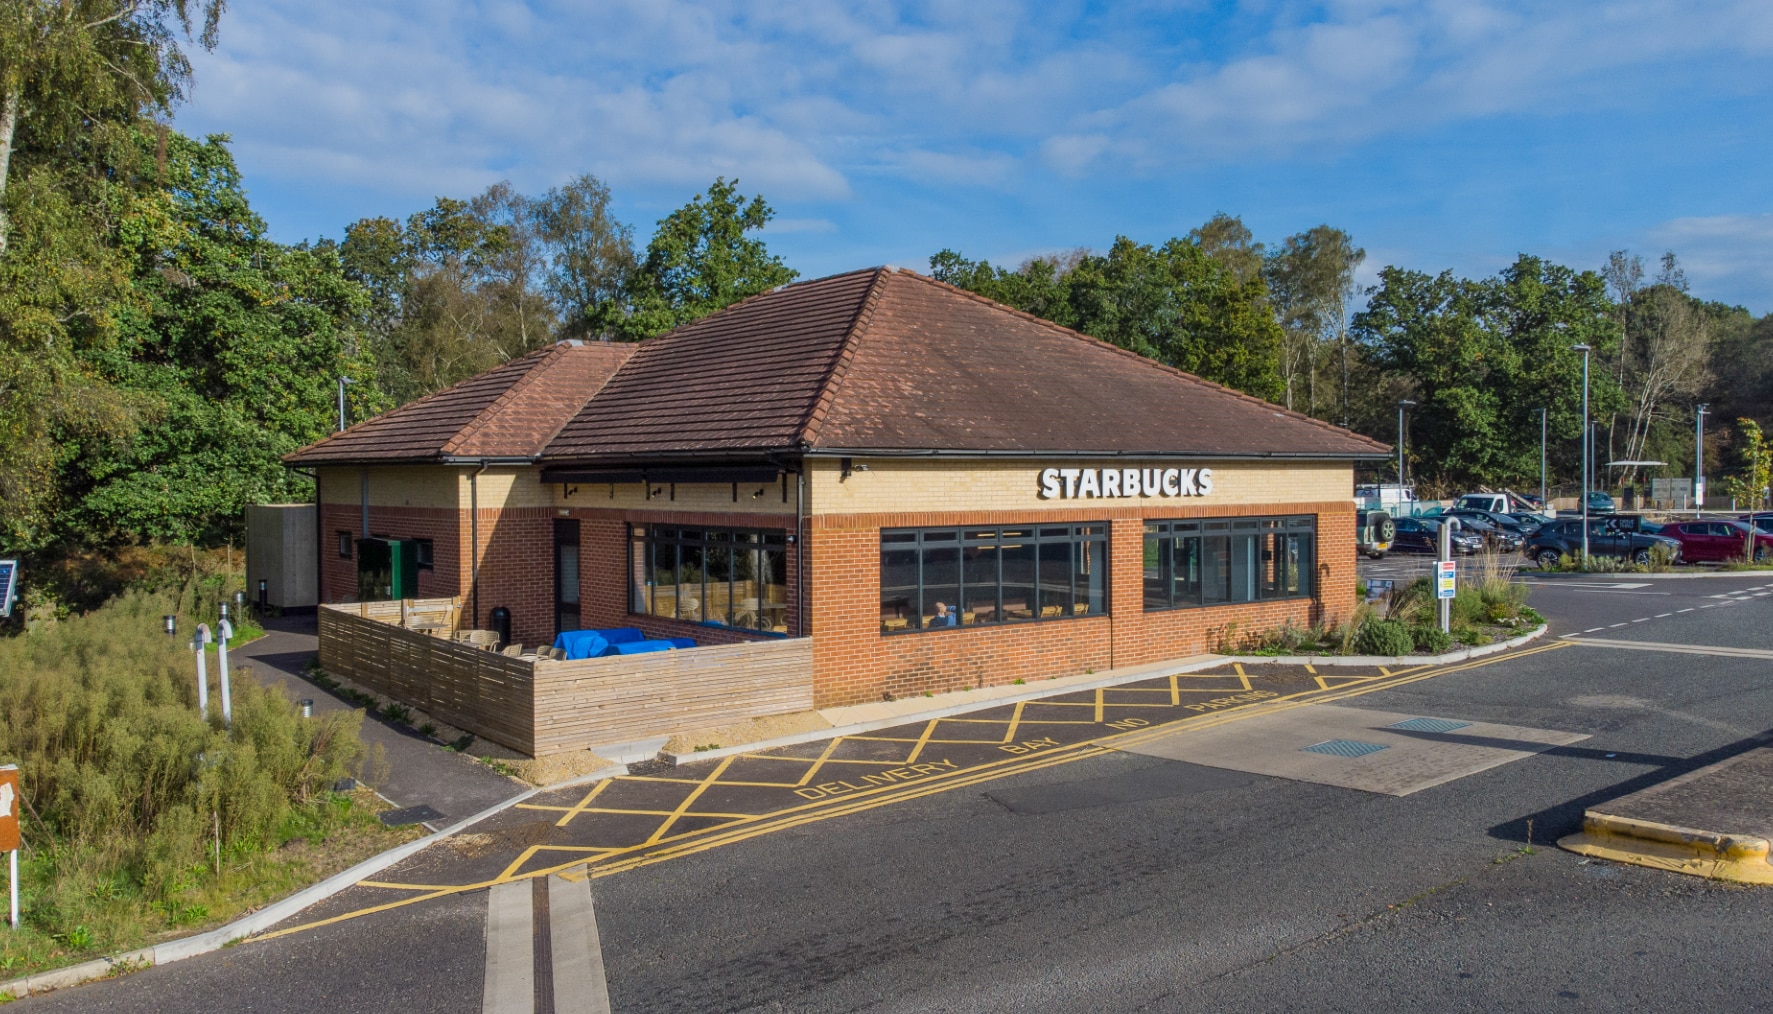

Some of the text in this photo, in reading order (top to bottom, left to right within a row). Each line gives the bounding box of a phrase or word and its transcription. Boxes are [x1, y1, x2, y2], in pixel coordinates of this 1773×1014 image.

[1042, 468, 1213, 498] STARBUCKS
[793, 690, 1279, 800] DELIVERY BAY NO PARKING
